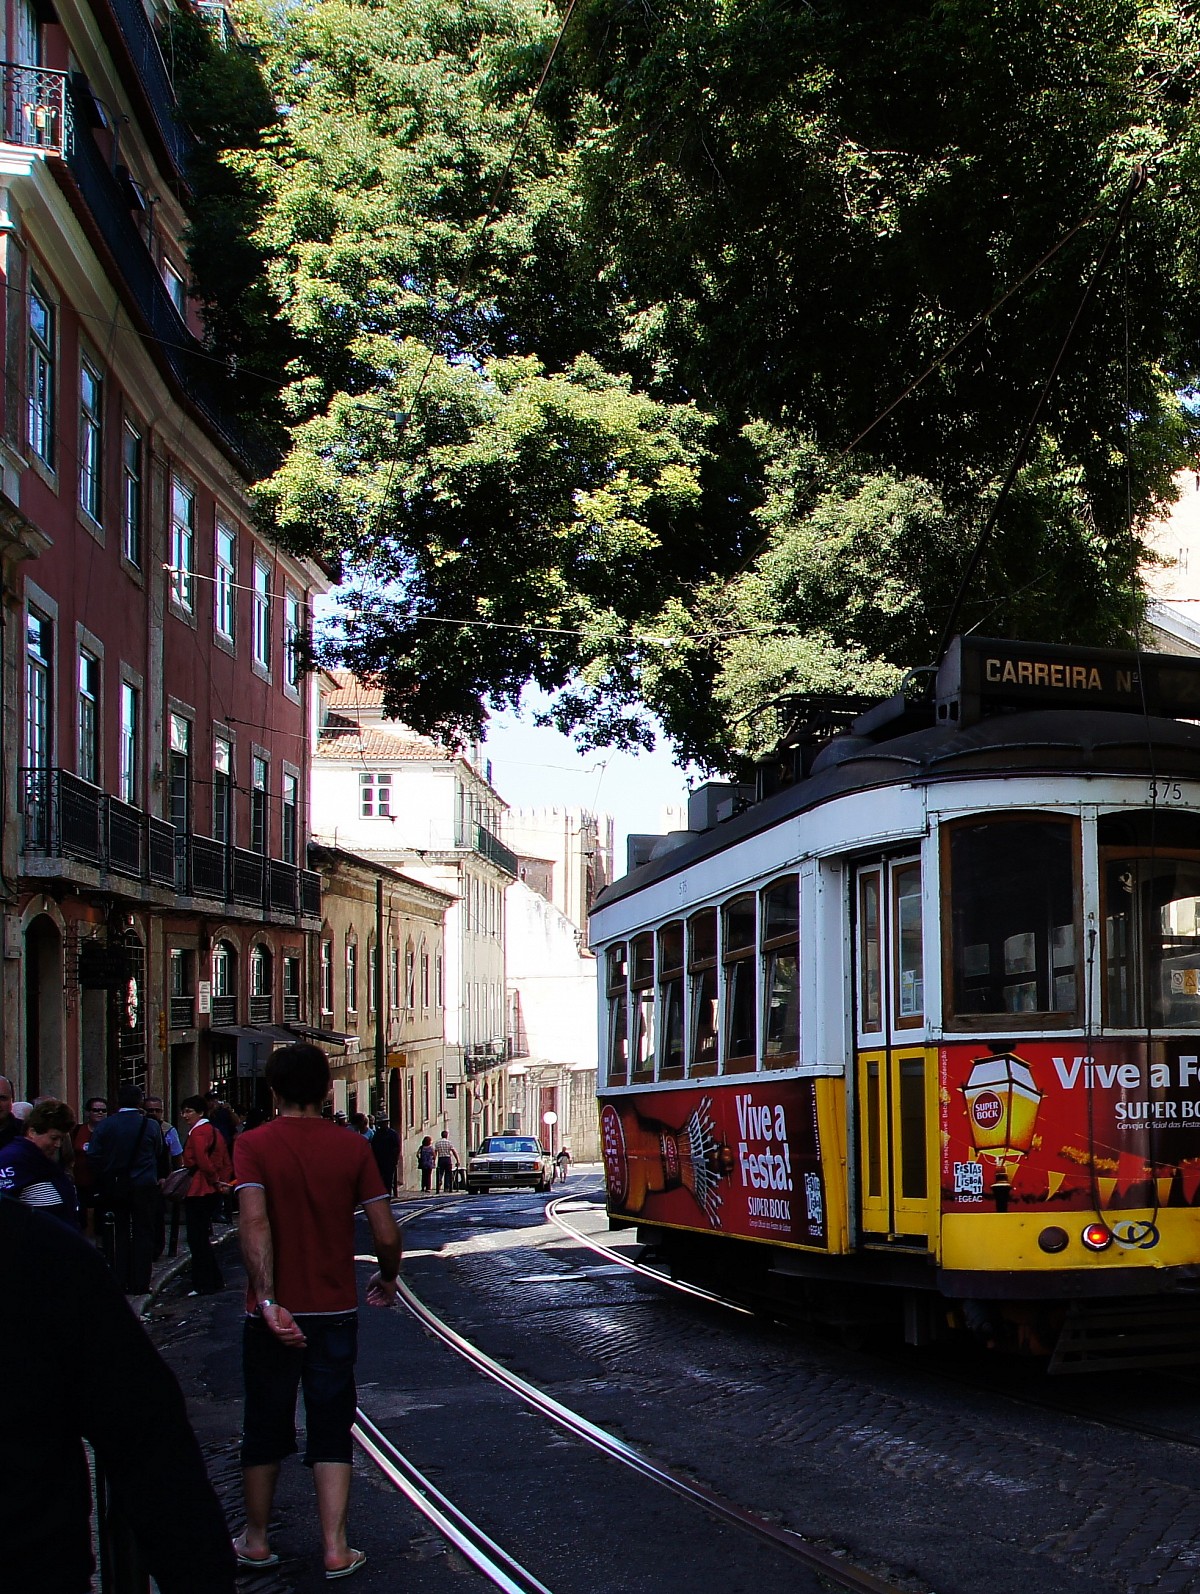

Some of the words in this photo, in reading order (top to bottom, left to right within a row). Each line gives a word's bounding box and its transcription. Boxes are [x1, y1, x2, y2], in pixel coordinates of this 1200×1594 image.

[986, 658, 1103, 691] CARREIRA
[1148, 782, 1181, 799] 575
[1052, 1055, 1140, 1089] Vive
[1150, 1063, 1171, 1088] a
[975, 1101, 999, 1112] SUPER
[976, 1110, 999, 1120] BOCK
[1114, 1101, 1178, 1120] SUPER
[735, 1093, 773, 1141] Vive
[774, 1104, 787, 1142] a
[1116, 1121, 1144, 1131] Cerveja
[1168, 1120, 1181, 1128] das
[738, 1142, 793, 1191] Festa!
[747, 1196, 770, 1217] SUPER
[769, 1198, 791, 1221] BOCK
[958, 1195, 983, 1203] EGEAC
